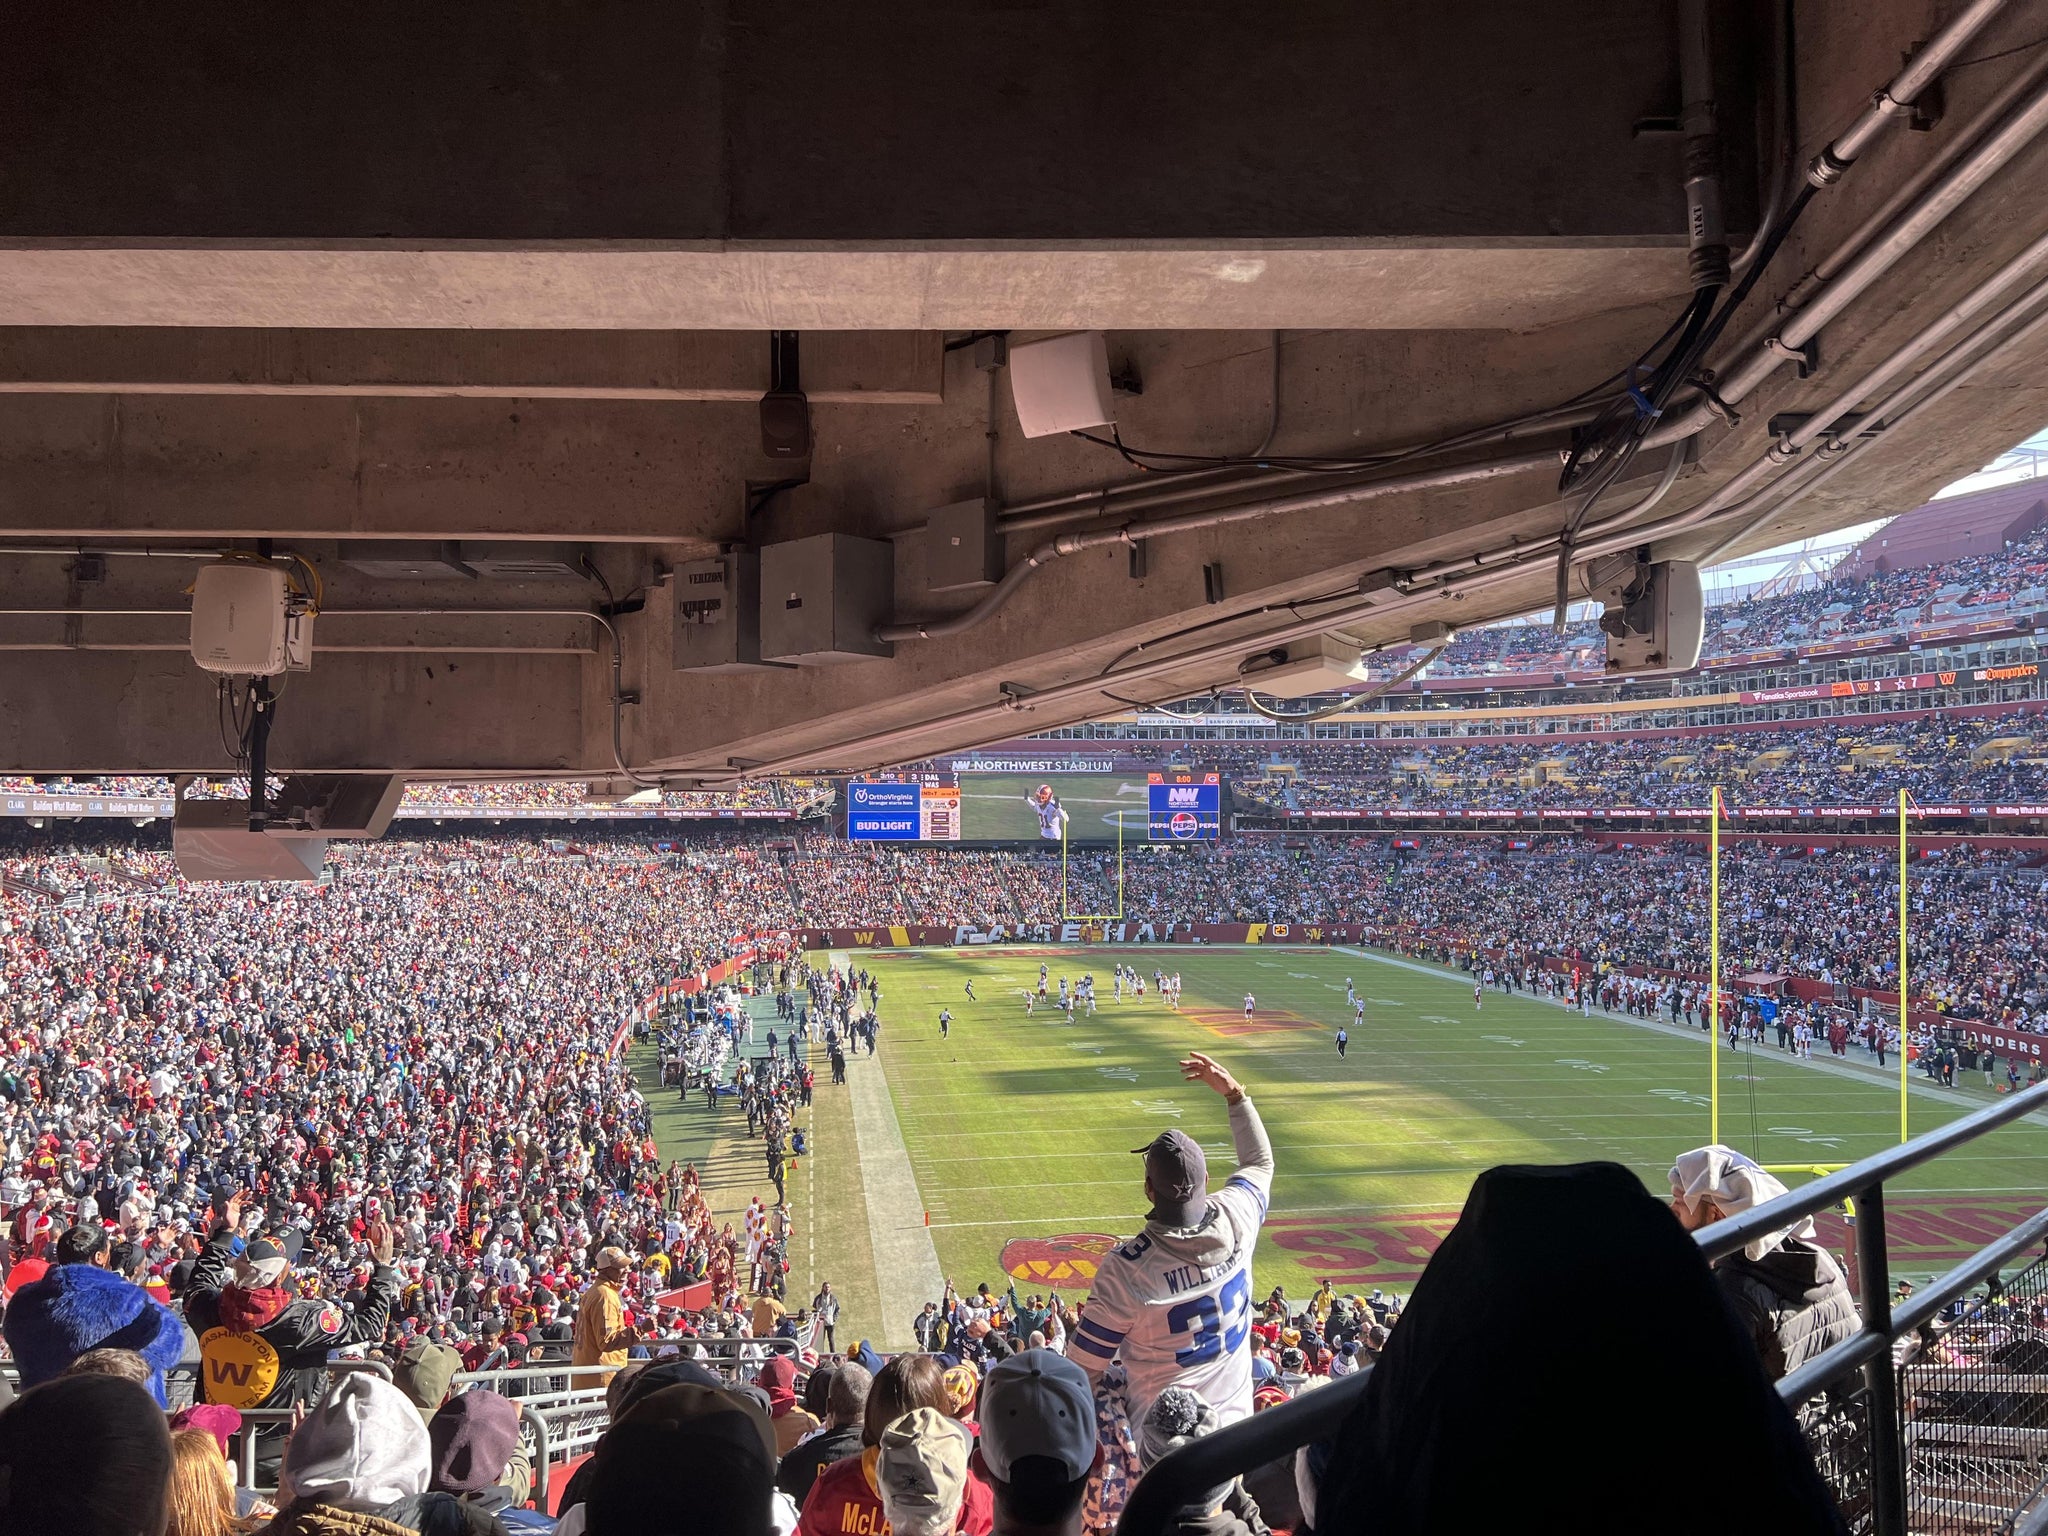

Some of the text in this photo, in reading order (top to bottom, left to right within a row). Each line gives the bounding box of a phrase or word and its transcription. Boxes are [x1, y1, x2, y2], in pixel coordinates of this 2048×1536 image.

[688, 571, 724, 585] VERIZON
[1874, 681, 1881, 692] 3
[1911, 677, 1918, 688] 7
[1761, 689, 1819, 701] Fanatics Sportsbook
[974, 761, 1053, 771] NORTHWEST
[1055, 761, 1113, 771] STADIUM
[953, 773, 959, 781] 7
[953, 781, 959, 789] 3
[868, 793, 913, 801] OrthoVirginia
[1821, 808, 1840, 816] Building
[1996, 806, 2019, 815] Building
[2020, 806, 2034, 814] What
[856, 822, 913, 830] BUD LIGHT
[1274, 925, 1287, 936] 25
[503, 1268, 509, 1282] 4
[209, 1357, 253, 1387] W
[240, 1381, 270, 1407] TEAM
